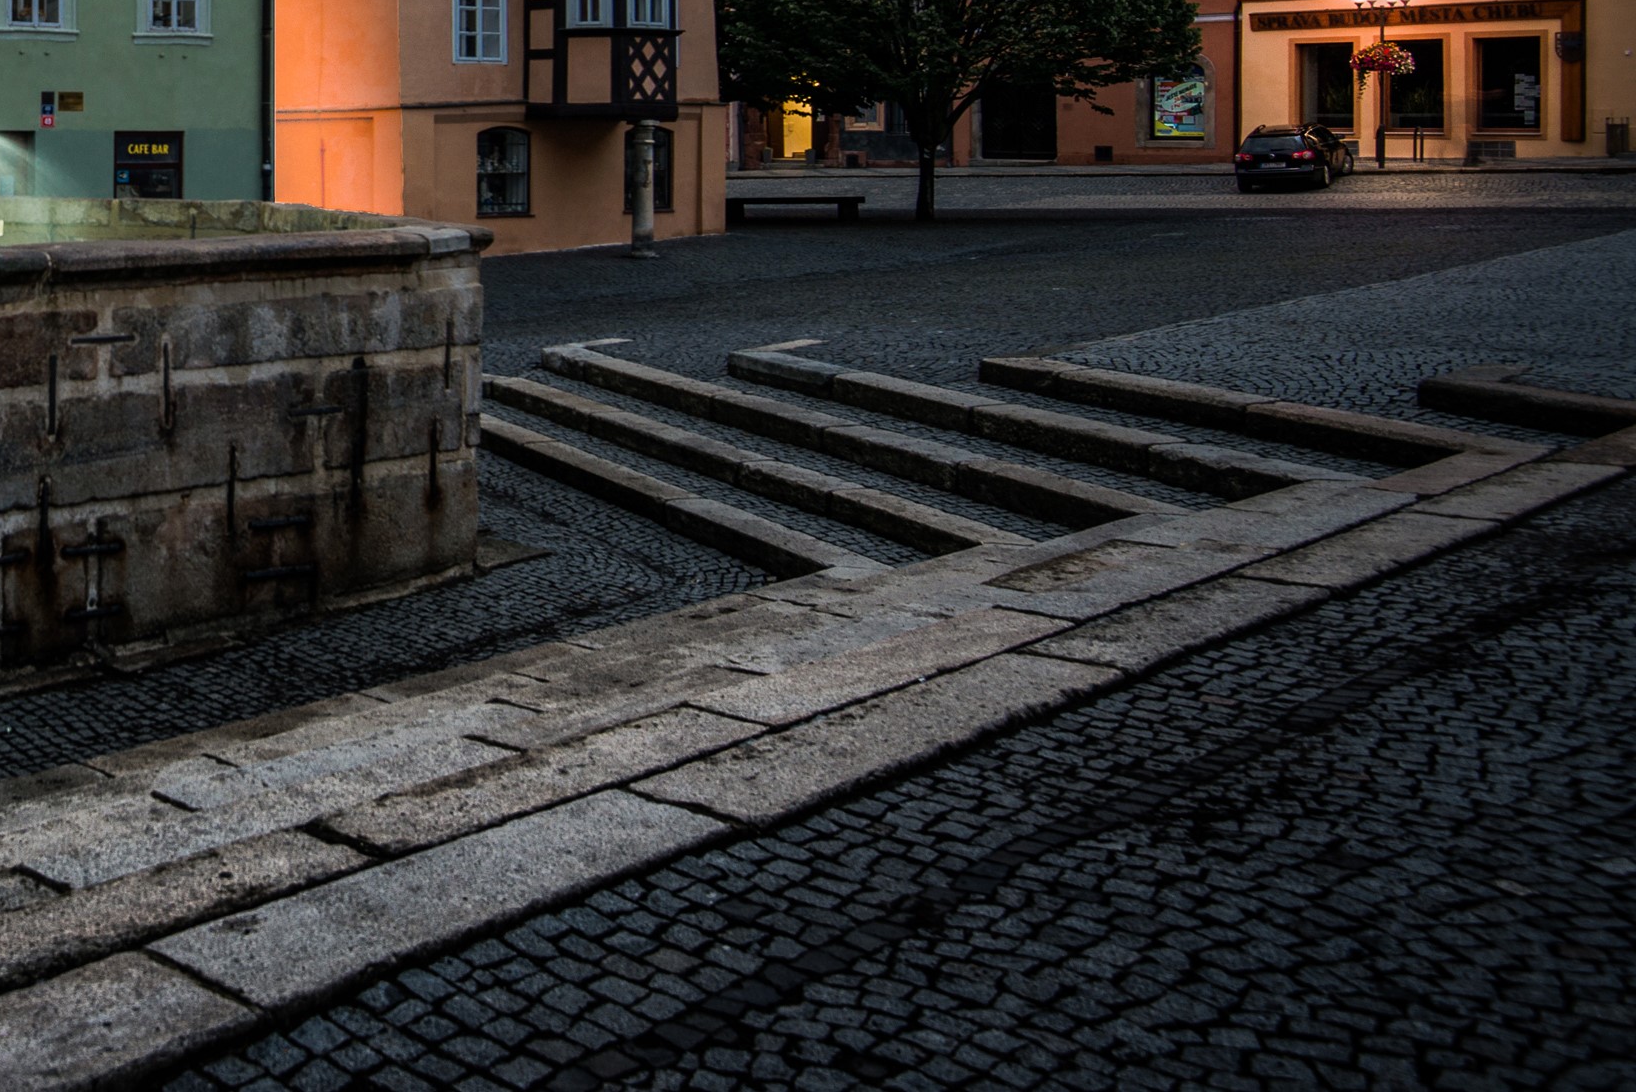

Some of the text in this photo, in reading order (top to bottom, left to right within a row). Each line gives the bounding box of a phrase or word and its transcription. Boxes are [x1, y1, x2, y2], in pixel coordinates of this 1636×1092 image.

[1257, 11, 1322, 29] SPRÁVA
[1399, 6, 1466, 24] MĚSTA
[1472, 3, 1542, 20] CHEBU
[151, 143, 170, 155] BAR
